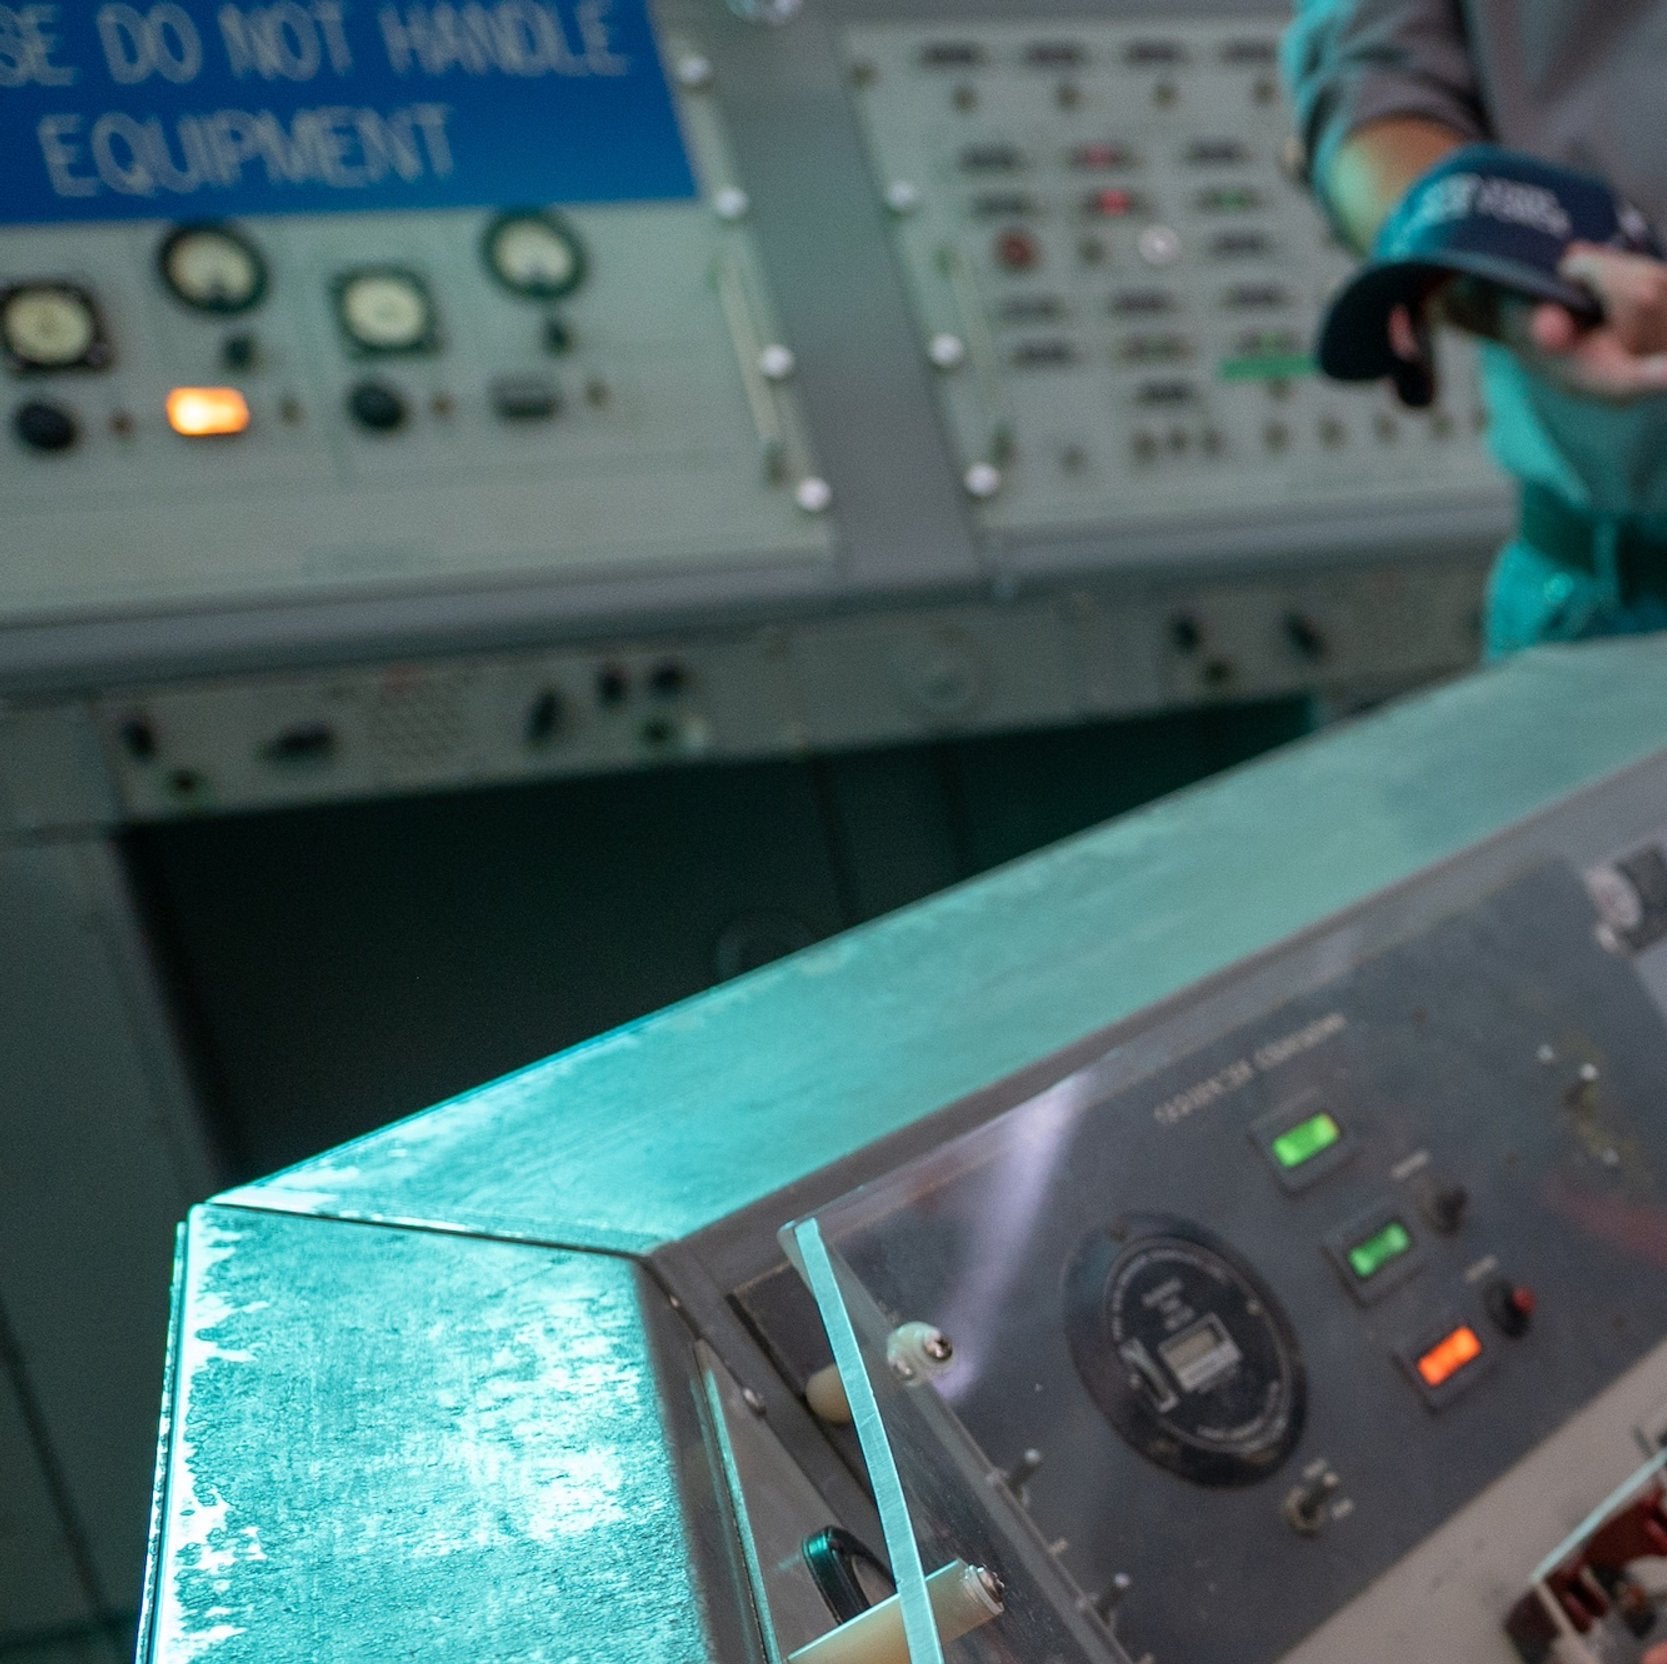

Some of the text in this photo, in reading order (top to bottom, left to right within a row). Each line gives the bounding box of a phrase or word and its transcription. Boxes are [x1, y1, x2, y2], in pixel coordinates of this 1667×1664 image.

[101, 2, 201, 85] DO
[217, 1, 353, 81] NOT
[380, 0, 629, 78] HANDLE
[36, 103, 455, 198] EQUIPMENT
